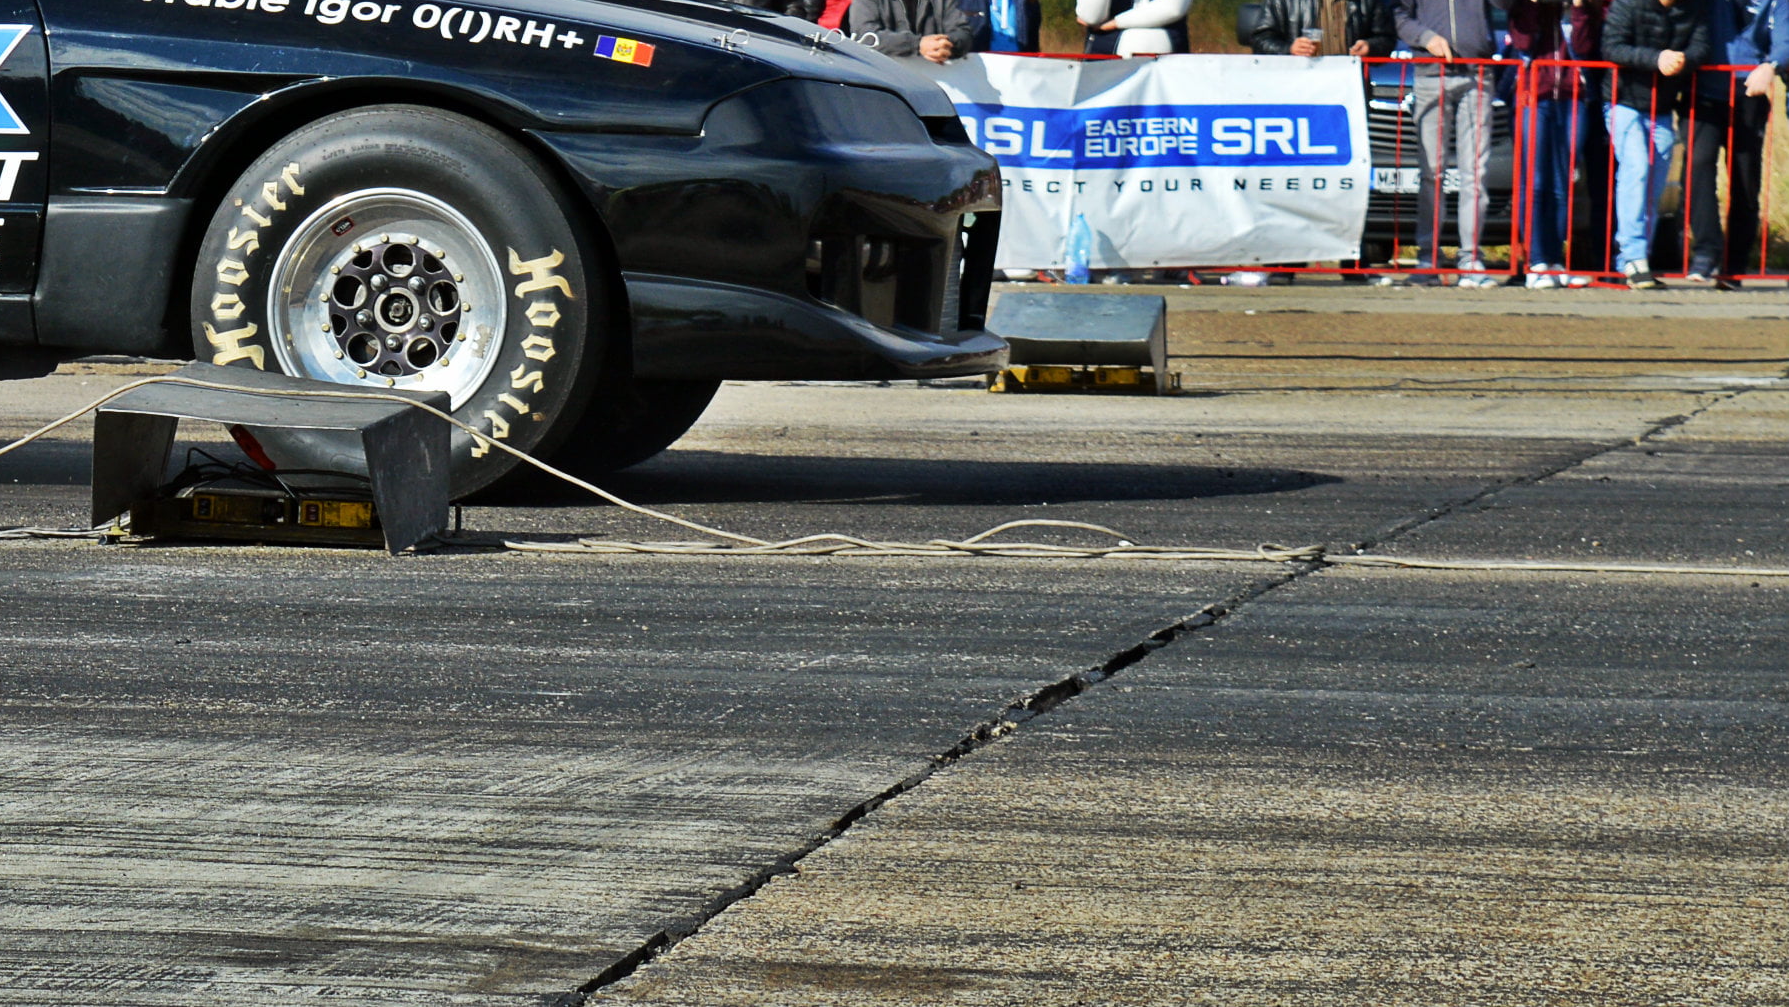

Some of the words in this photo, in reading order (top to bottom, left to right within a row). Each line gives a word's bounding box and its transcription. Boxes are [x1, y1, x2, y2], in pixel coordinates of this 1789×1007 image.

[1085, 117, 1198, 137] EASTERN
[1211, 117, 1338, 156] SRL
[1084, 136, 1198, 158] EUROPE
[1114, 178, 1203, 192] YOUR
[1233, 176, 1354, 191] NEEDS
[202, 162, 305, 371] Hoosier
